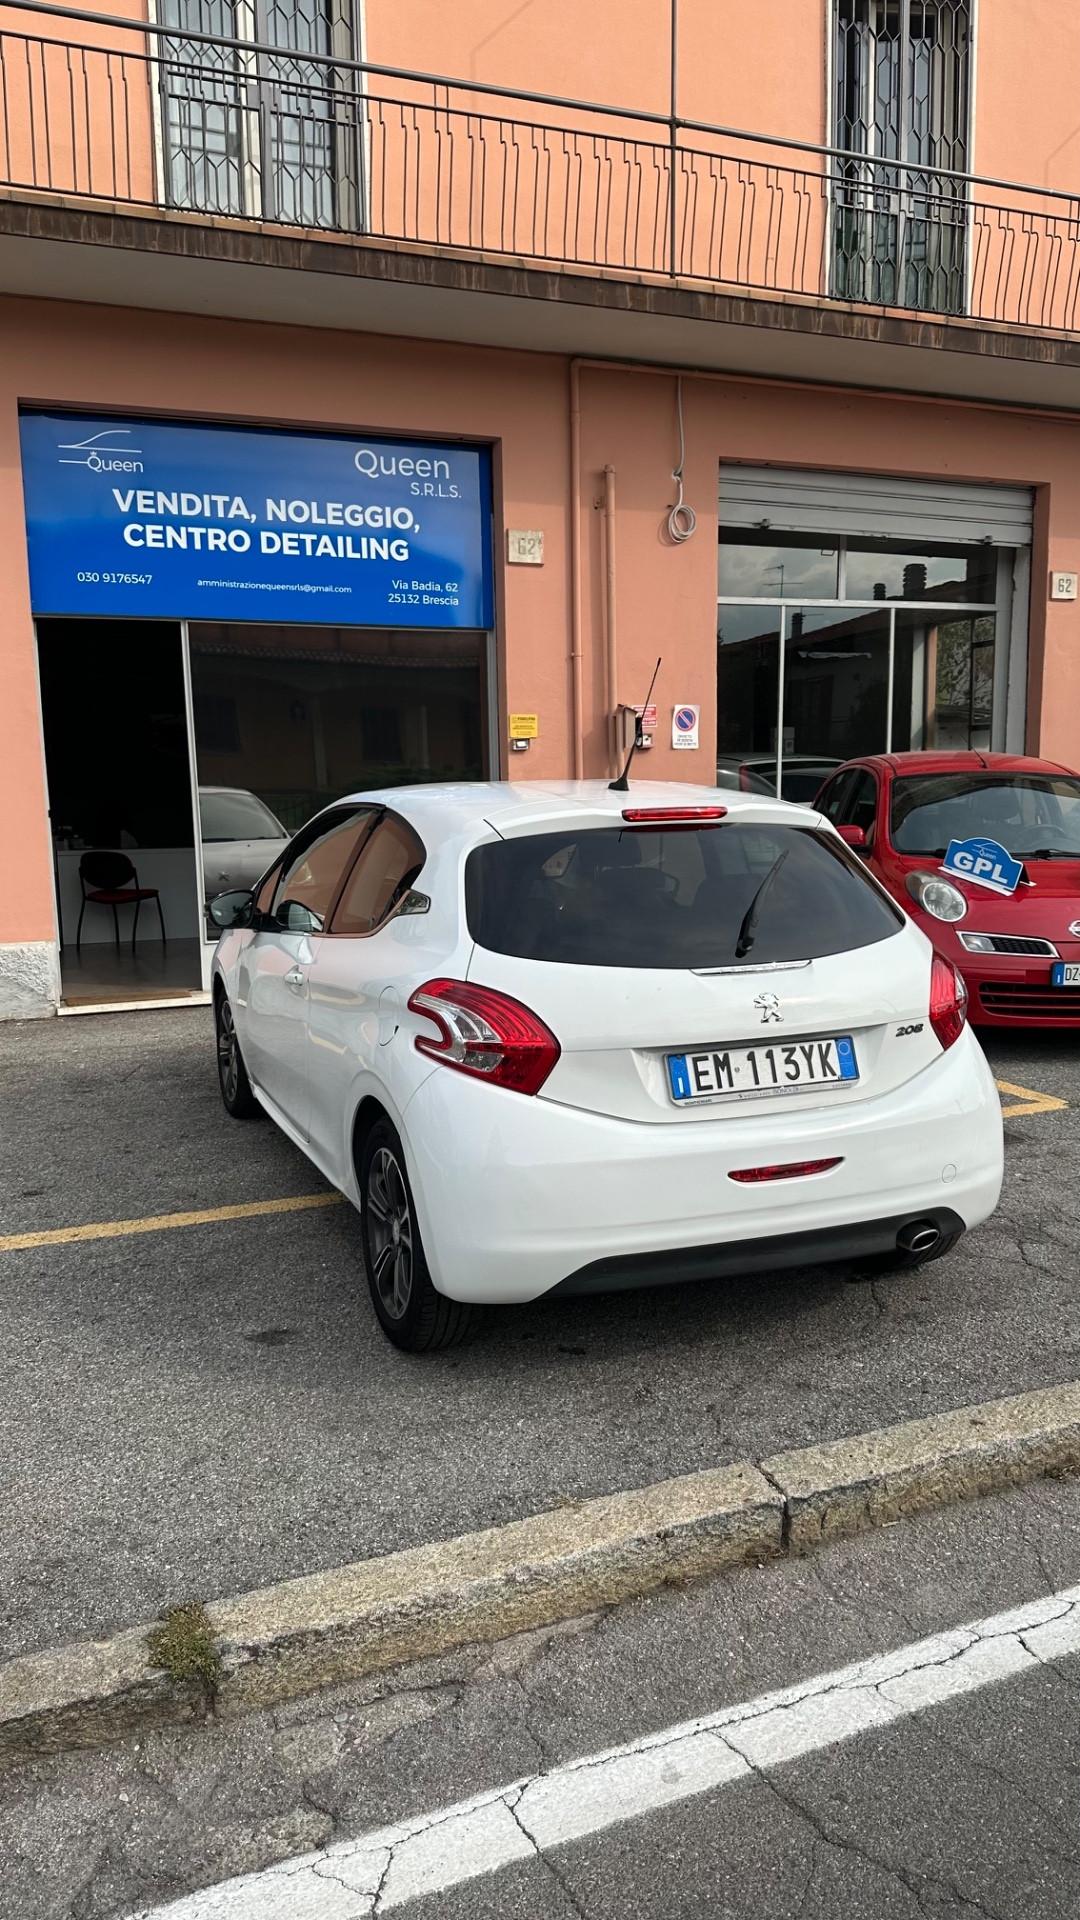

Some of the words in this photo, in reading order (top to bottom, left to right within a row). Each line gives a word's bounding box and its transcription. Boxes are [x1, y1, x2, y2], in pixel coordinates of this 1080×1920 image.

[87, 455, 144, 472] Queen
[354, 449, 450, 479] Queen
[410, 482, 462, 498] S.R.L.S.
[112, 488, 257, 524] VENDITA,
[266, 499, 420, 533] NOLEGGIO,
[123, 523, 250, 552] CENTRO
[260, 531, 409, 561] DETAILING
[77, 572, 99, 583] 030
[102, 573, 153, 584] 9176547
[1058, 578, 1072, 593] 62
[197, 579, 352, 593] amministrazionequeensrls@gmail.com
[391, 580, 409, 590] Via
[411, 581, 444, 593] Badia,
[445, 582, 459, 592] 62
[387, 593, 420, 604] 25132
[422, 594, 459, 606] Brescia
[953, 851, 1008, 884] GPL
[1065, 967, 1079, 981] DZ
[895, 1023, 924, 1037] 208
[692, 1053, 734, 1091] EM
[746, 1043, 837, 1085] 113YK
